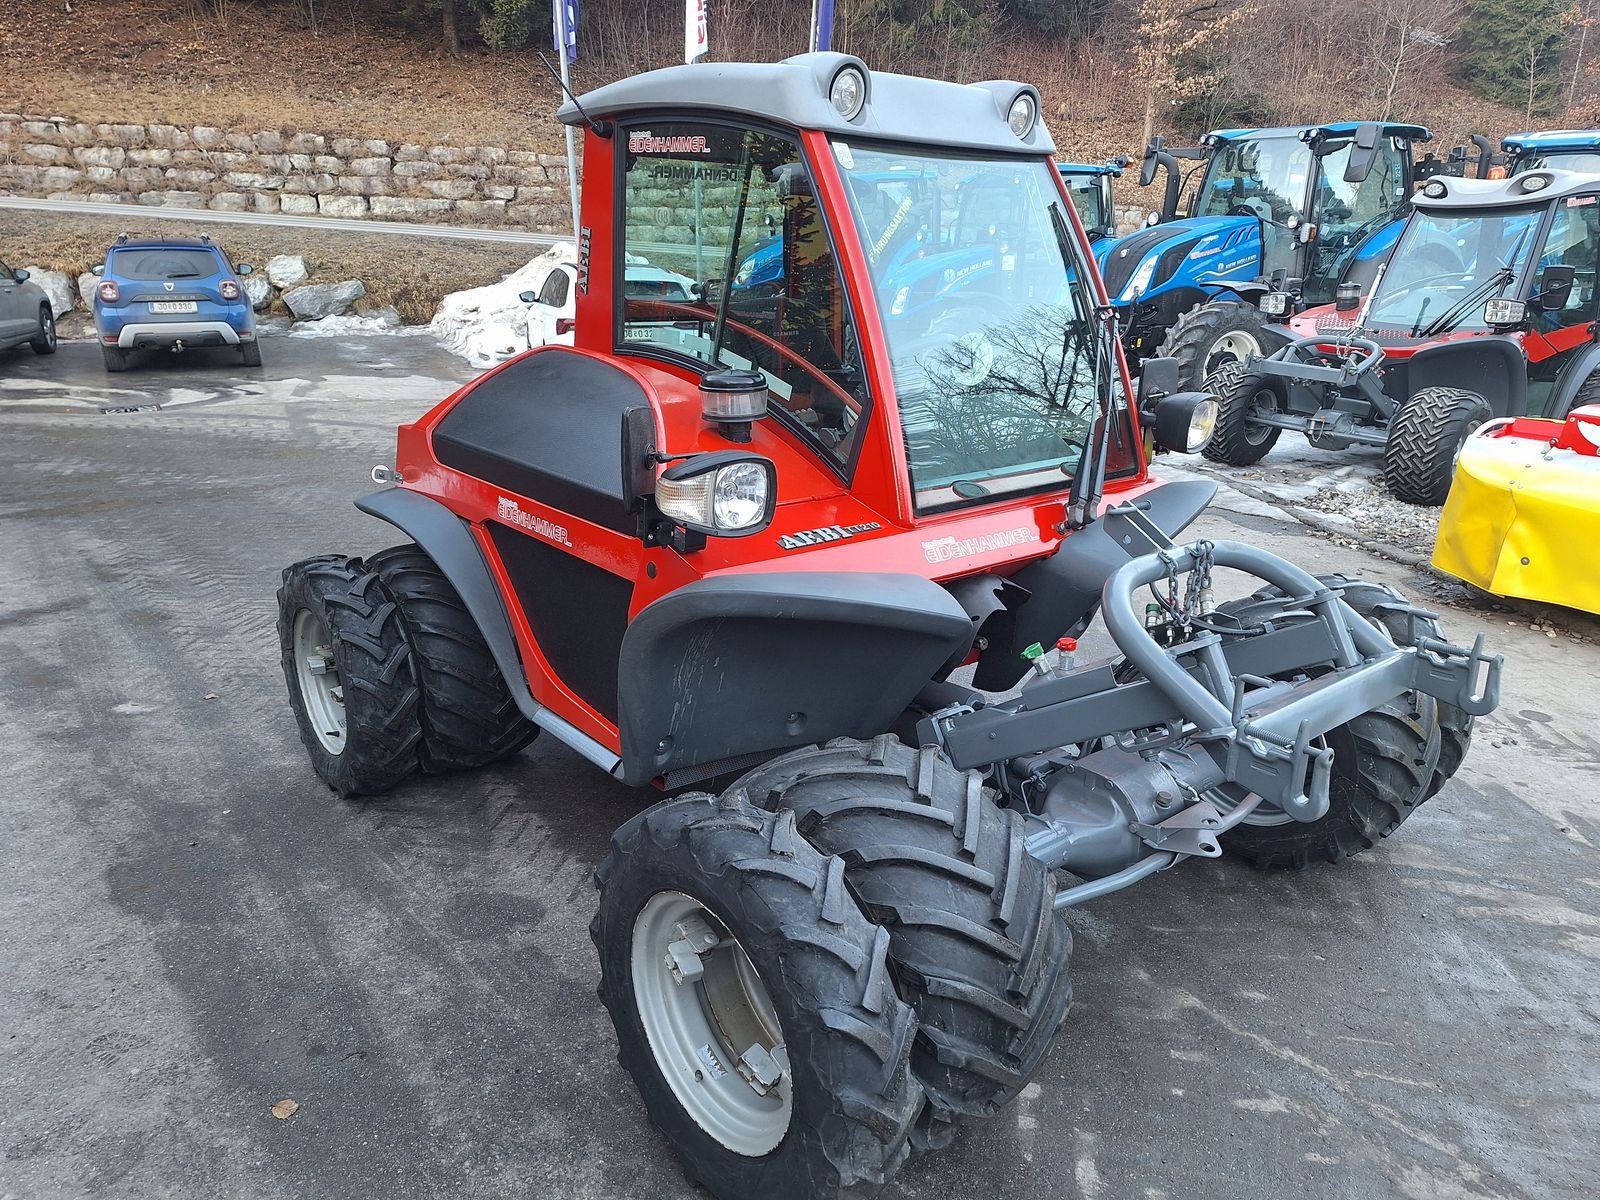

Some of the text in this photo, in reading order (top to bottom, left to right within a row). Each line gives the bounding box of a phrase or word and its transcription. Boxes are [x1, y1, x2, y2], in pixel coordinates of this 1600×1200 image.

[628, 136, 710, 153] EIDENHAMMER
[498, 503, 573, 547] EIDENHAMMER
[777, 525, 853, 549] AEBI
[924, 527, 1040, 563] EIDENHAMMER
